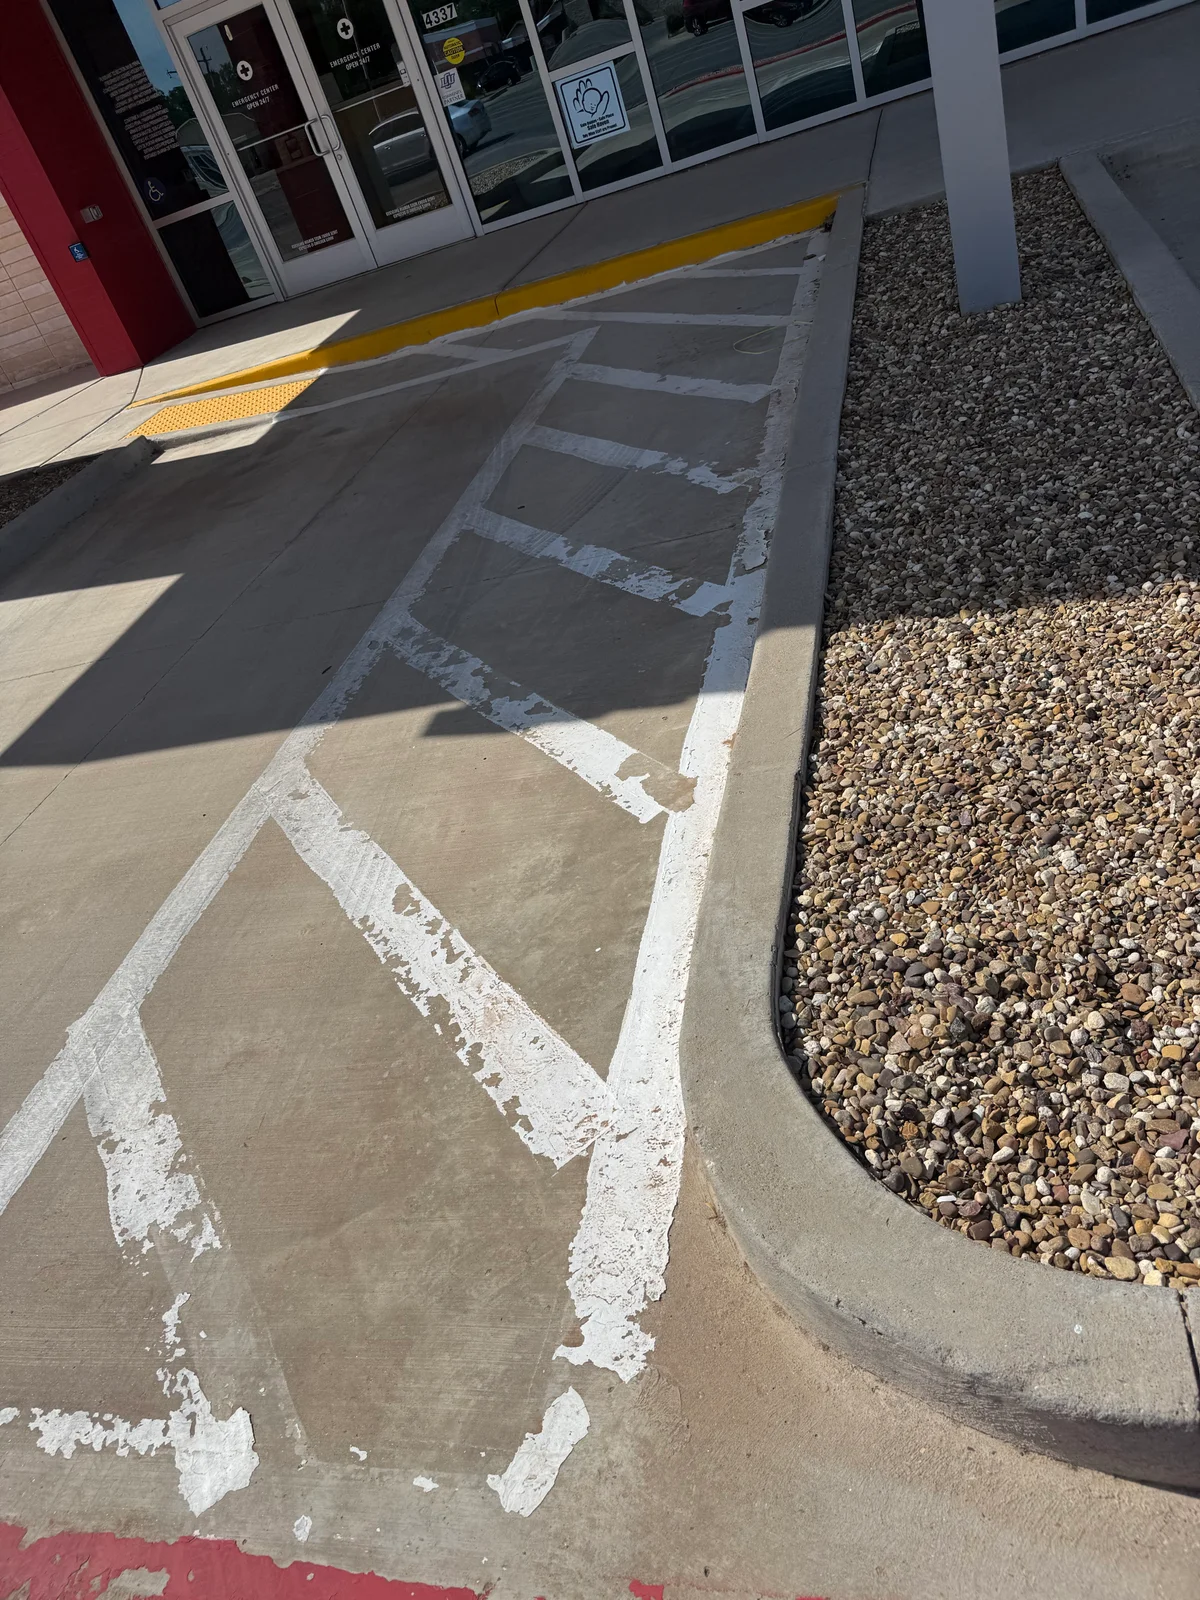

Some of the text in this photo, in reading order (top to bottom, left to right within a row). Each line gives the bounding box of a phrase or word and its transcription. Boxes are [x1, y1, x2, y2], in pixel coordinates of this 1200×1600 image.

[425, 4, 454, 26] 4337
[329, 42, 380, 68] EMERGENCY CENTER
[345, 56, 370, 70] OPEN 24/7
[231, 84, 279, 108] EMERGENCY CENTER
[246, 96, 270, 110] OPEN 24/7
